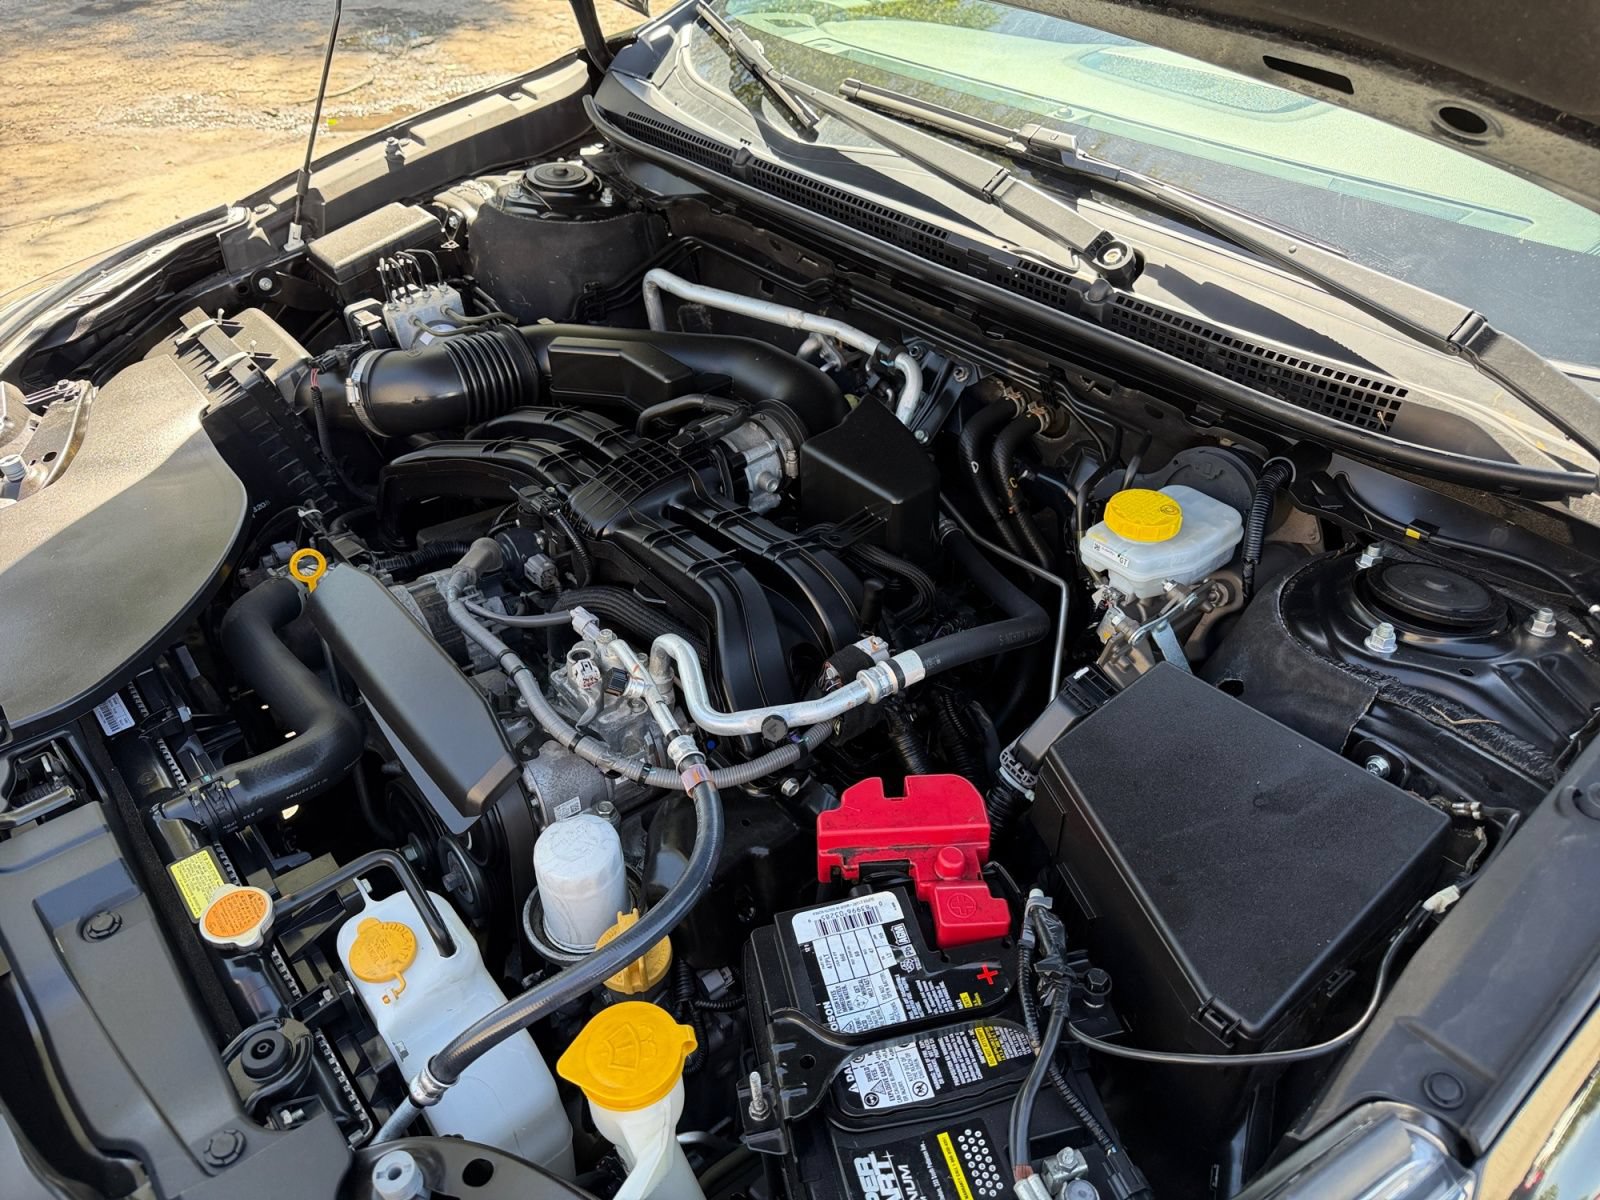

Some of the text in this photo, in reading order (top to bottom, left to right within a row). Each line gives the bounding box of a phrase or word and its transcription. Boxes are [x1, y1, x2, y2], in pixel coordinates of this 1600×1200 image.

[893, 923, 908, 944] AGM
[905, 945, 913, 955] Pb
[823, 952, 833, 969] 47PLT
[857, 978, 867, 996] MEDICAL
[835, 985, 848, 1012] IMMEDIATELY
[822, 1000, 838, 1031] OISON
[906, 1057, 916, 1071] REACH
[863, 1066, 873, 1082] SHIELD
[877, 1062, 895, 1101] EXPLOSIVE GASES
[905, 1070, 913, 1081] KEEP
